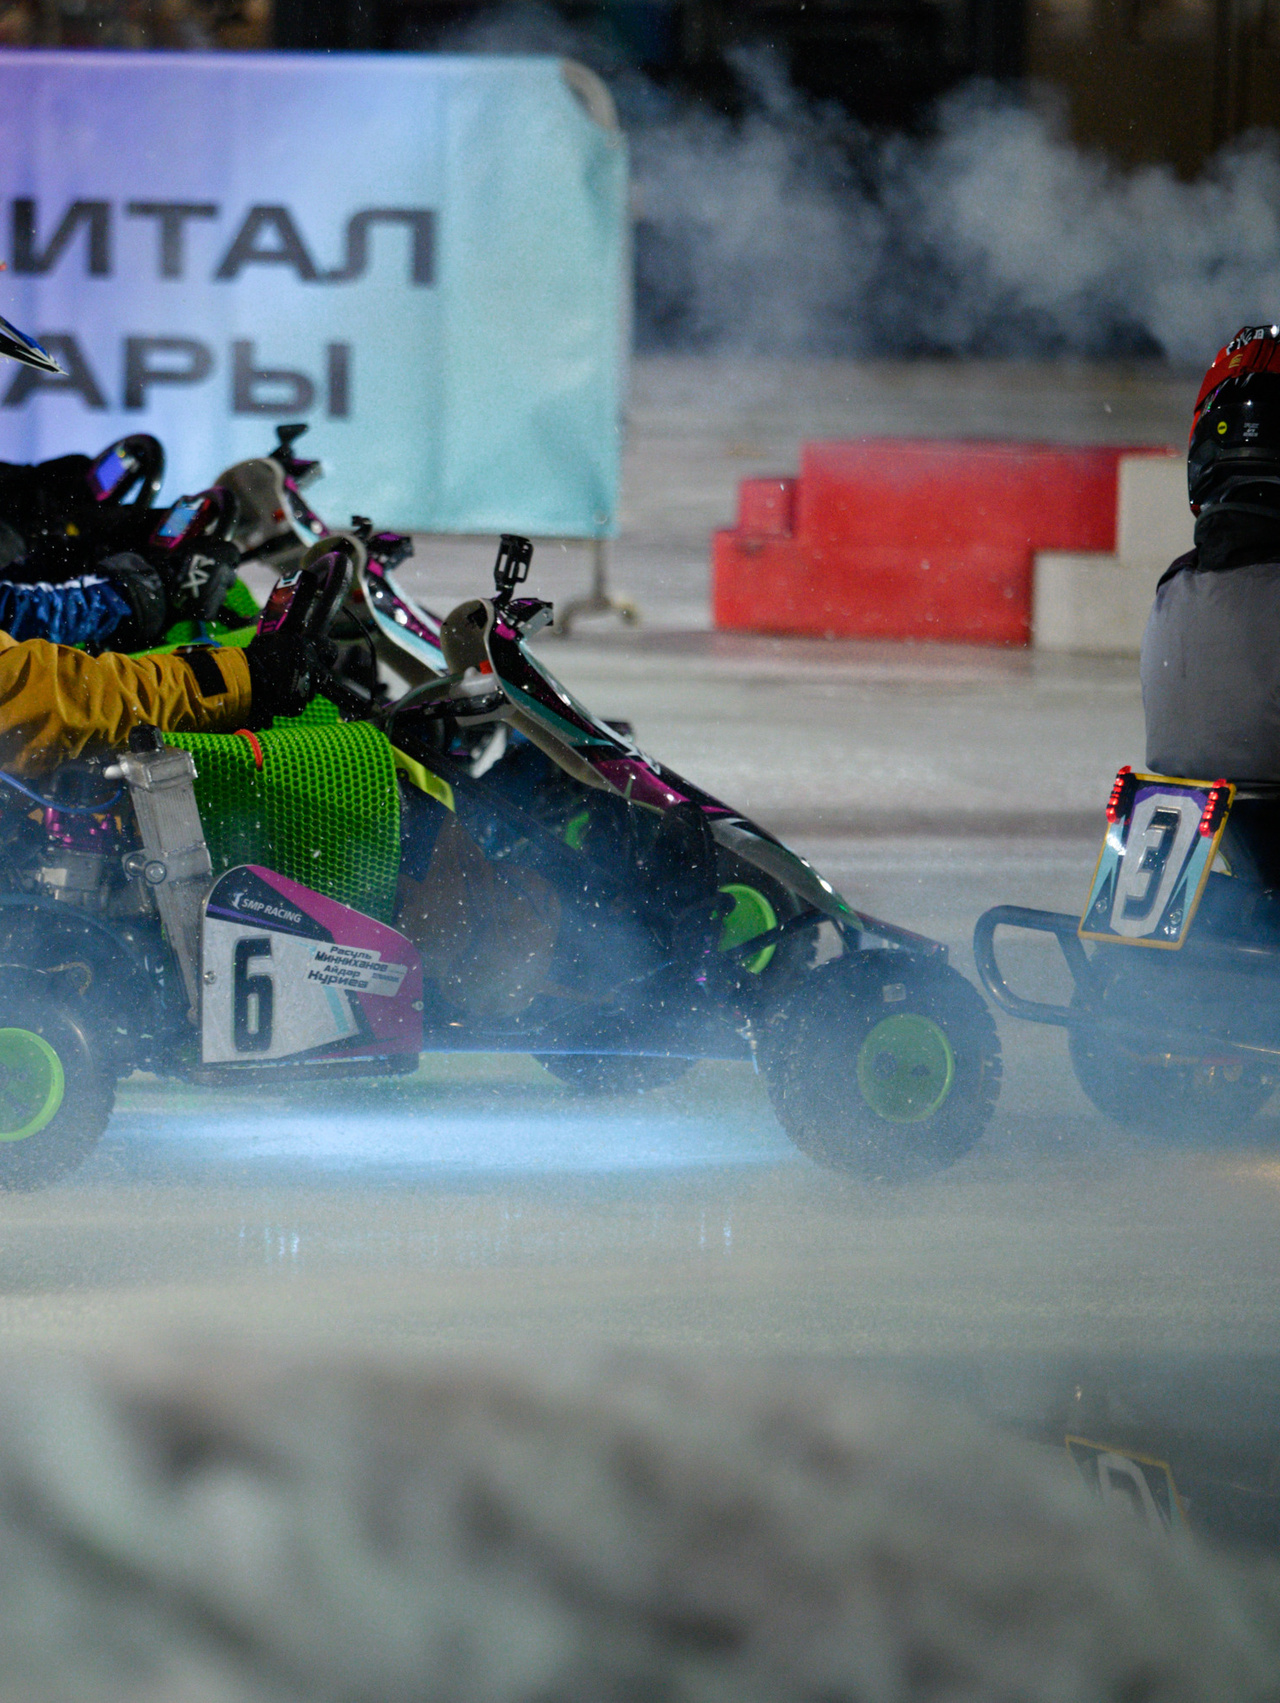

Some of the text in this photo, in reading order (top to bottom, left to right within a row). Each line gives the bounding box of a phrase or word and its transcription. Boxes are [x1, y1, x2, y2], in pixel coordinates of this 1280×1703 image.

[1121, 805, 1182, 922] 3
[241, 898, 303, 923] SMP RACING
[314, 950, 389, 973] Минниханов
[330, 946, 372, 960] Расуль
[323, 964, 361, 979] Айдар
[233, 934, 274, 1053] 6
